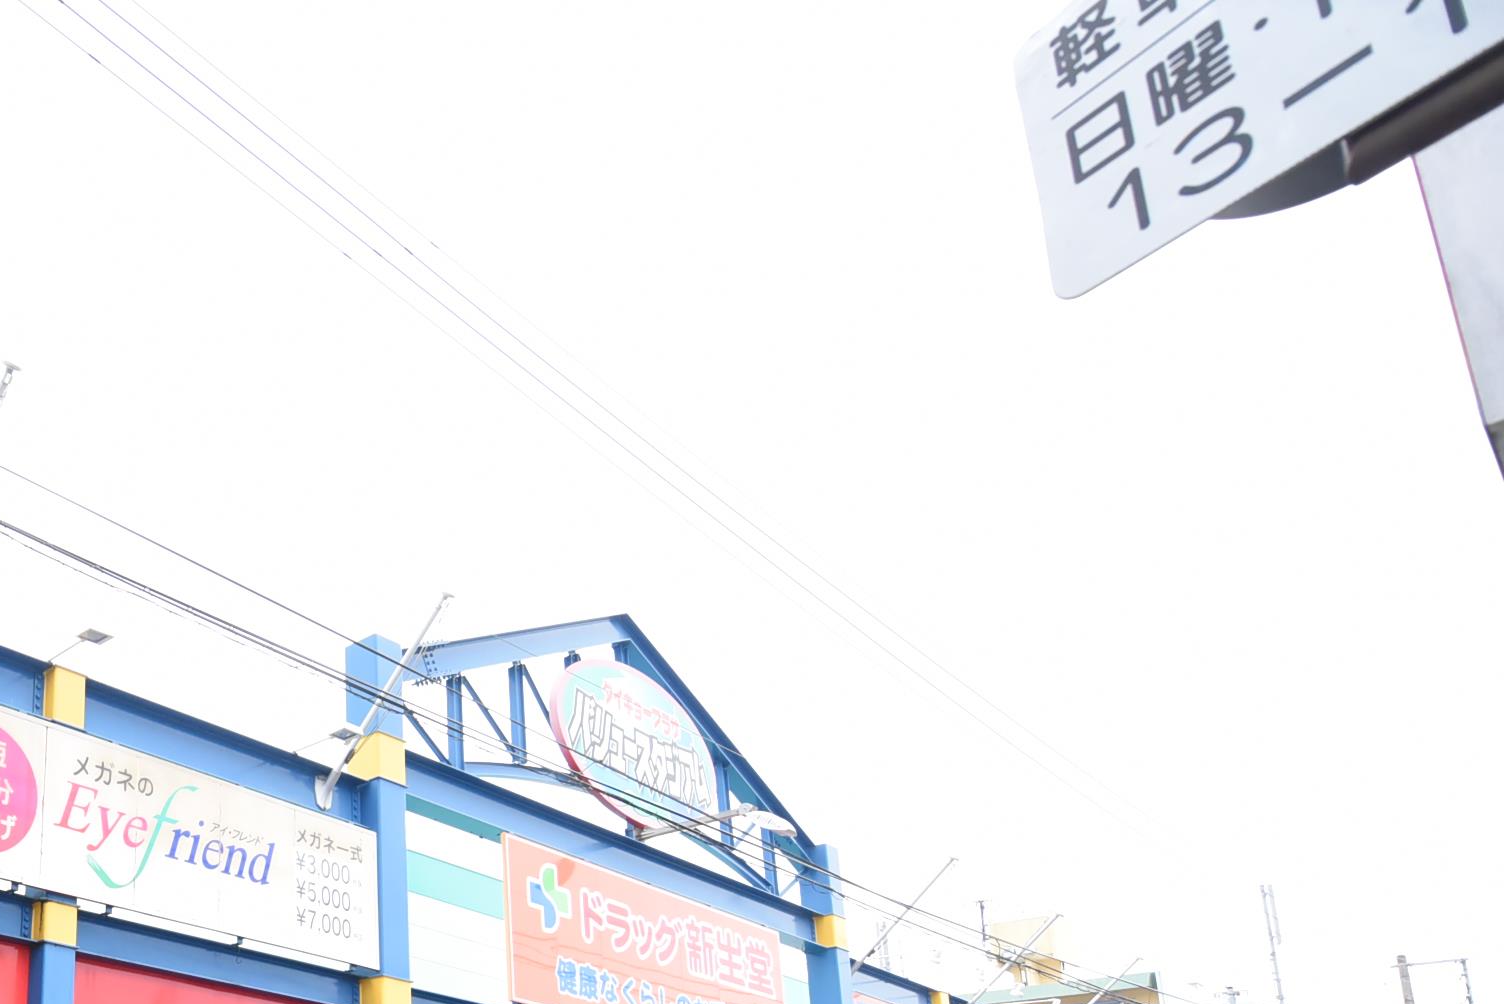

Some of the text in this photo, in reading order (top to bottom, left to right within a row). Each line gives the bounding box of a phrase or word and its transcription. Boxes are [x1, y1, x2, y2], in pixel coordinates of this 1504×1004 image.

[72, 756, 154, 798] メガネの
[296, 828, 364, 863] メガネ一式
[579, 888, 776, 997] ドラッグ新生堂
